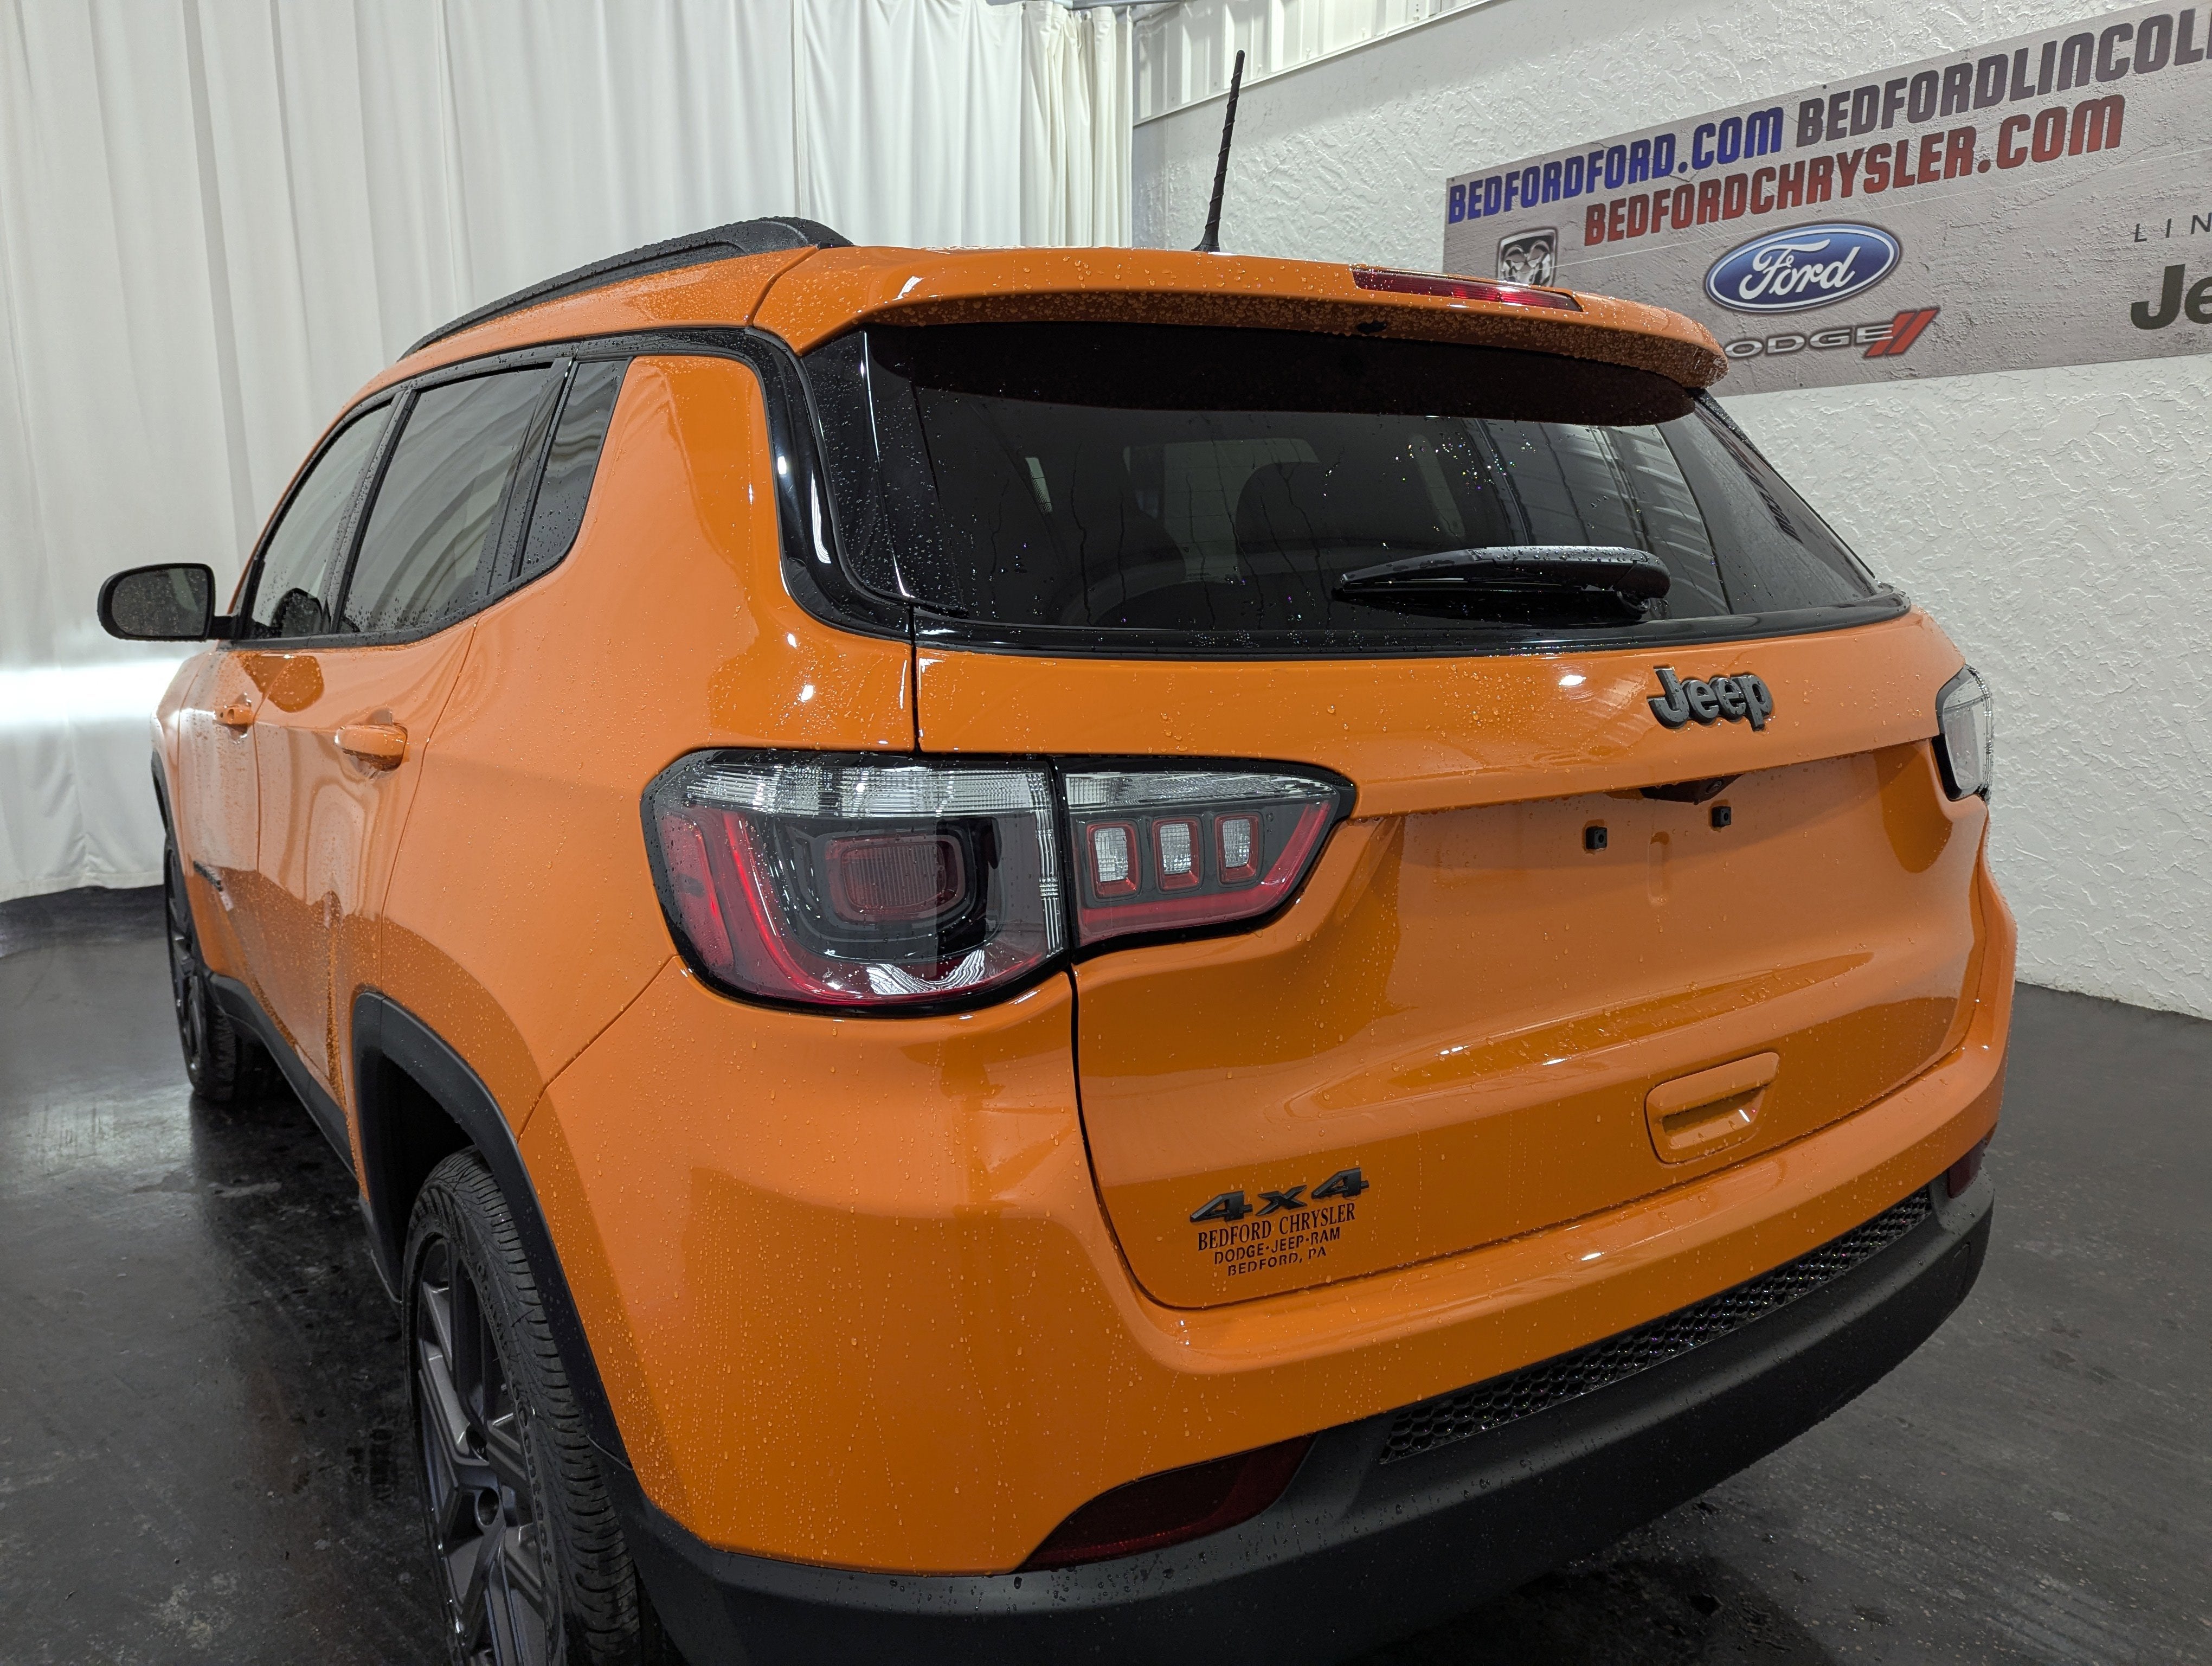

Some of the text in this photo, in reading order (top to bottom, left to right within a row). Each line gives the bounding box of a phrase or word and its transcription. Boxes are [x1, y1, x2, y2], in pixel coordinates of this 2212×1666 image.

[1448, 8, 2212, 224] BEDFORDFORD.COM BEDFORDLINCOL
[1584, 94, 2125, 246] BEDFORDCHRYSLER.COM
[2134, 212, 2212, 242] LIN
[1739, 239, 1861, 300] Ford
[1724, 324, 1894, 358] ODGE
[1647, 668, 1773, 732] Jeep
[1198, 1202, 1355, 1251] BEDFORD CHRYSLER
[1228, 1246, 1327, 1277] BEDFORD, PA
